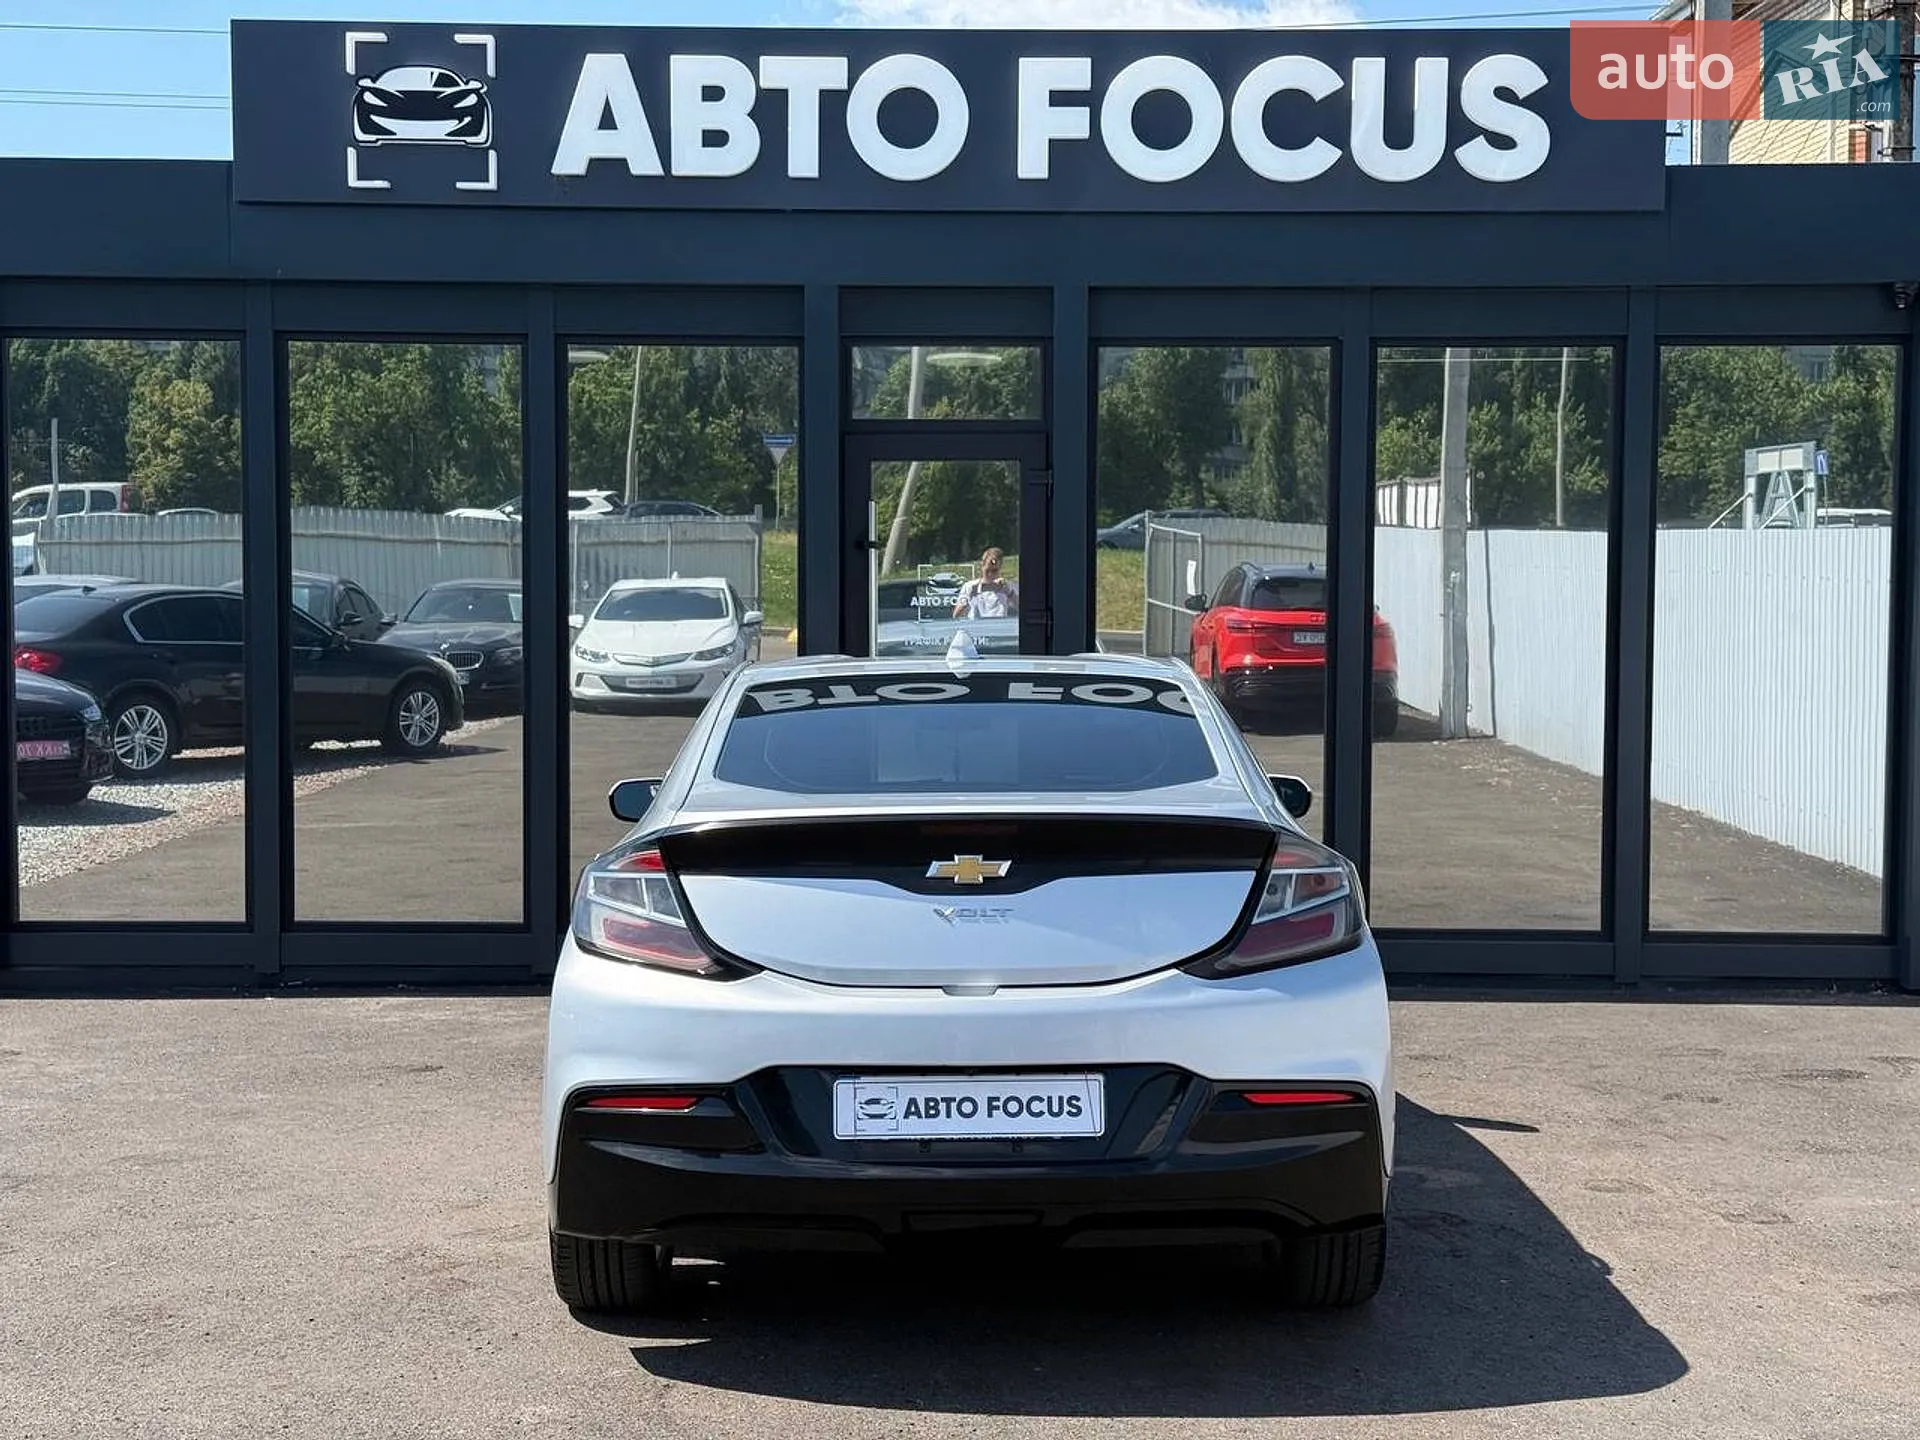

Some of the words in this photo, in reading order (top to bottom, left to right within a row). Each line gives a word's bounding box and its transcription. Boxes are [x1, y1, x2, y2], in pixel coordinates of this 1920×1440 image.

[550, 52, 970, 182] АВТО
[1016, 53, 1551, 183] FOCUS
[903, 1096, 979, 1119] АВТО
[986, 1095, 1083, 1119] FOCUS
